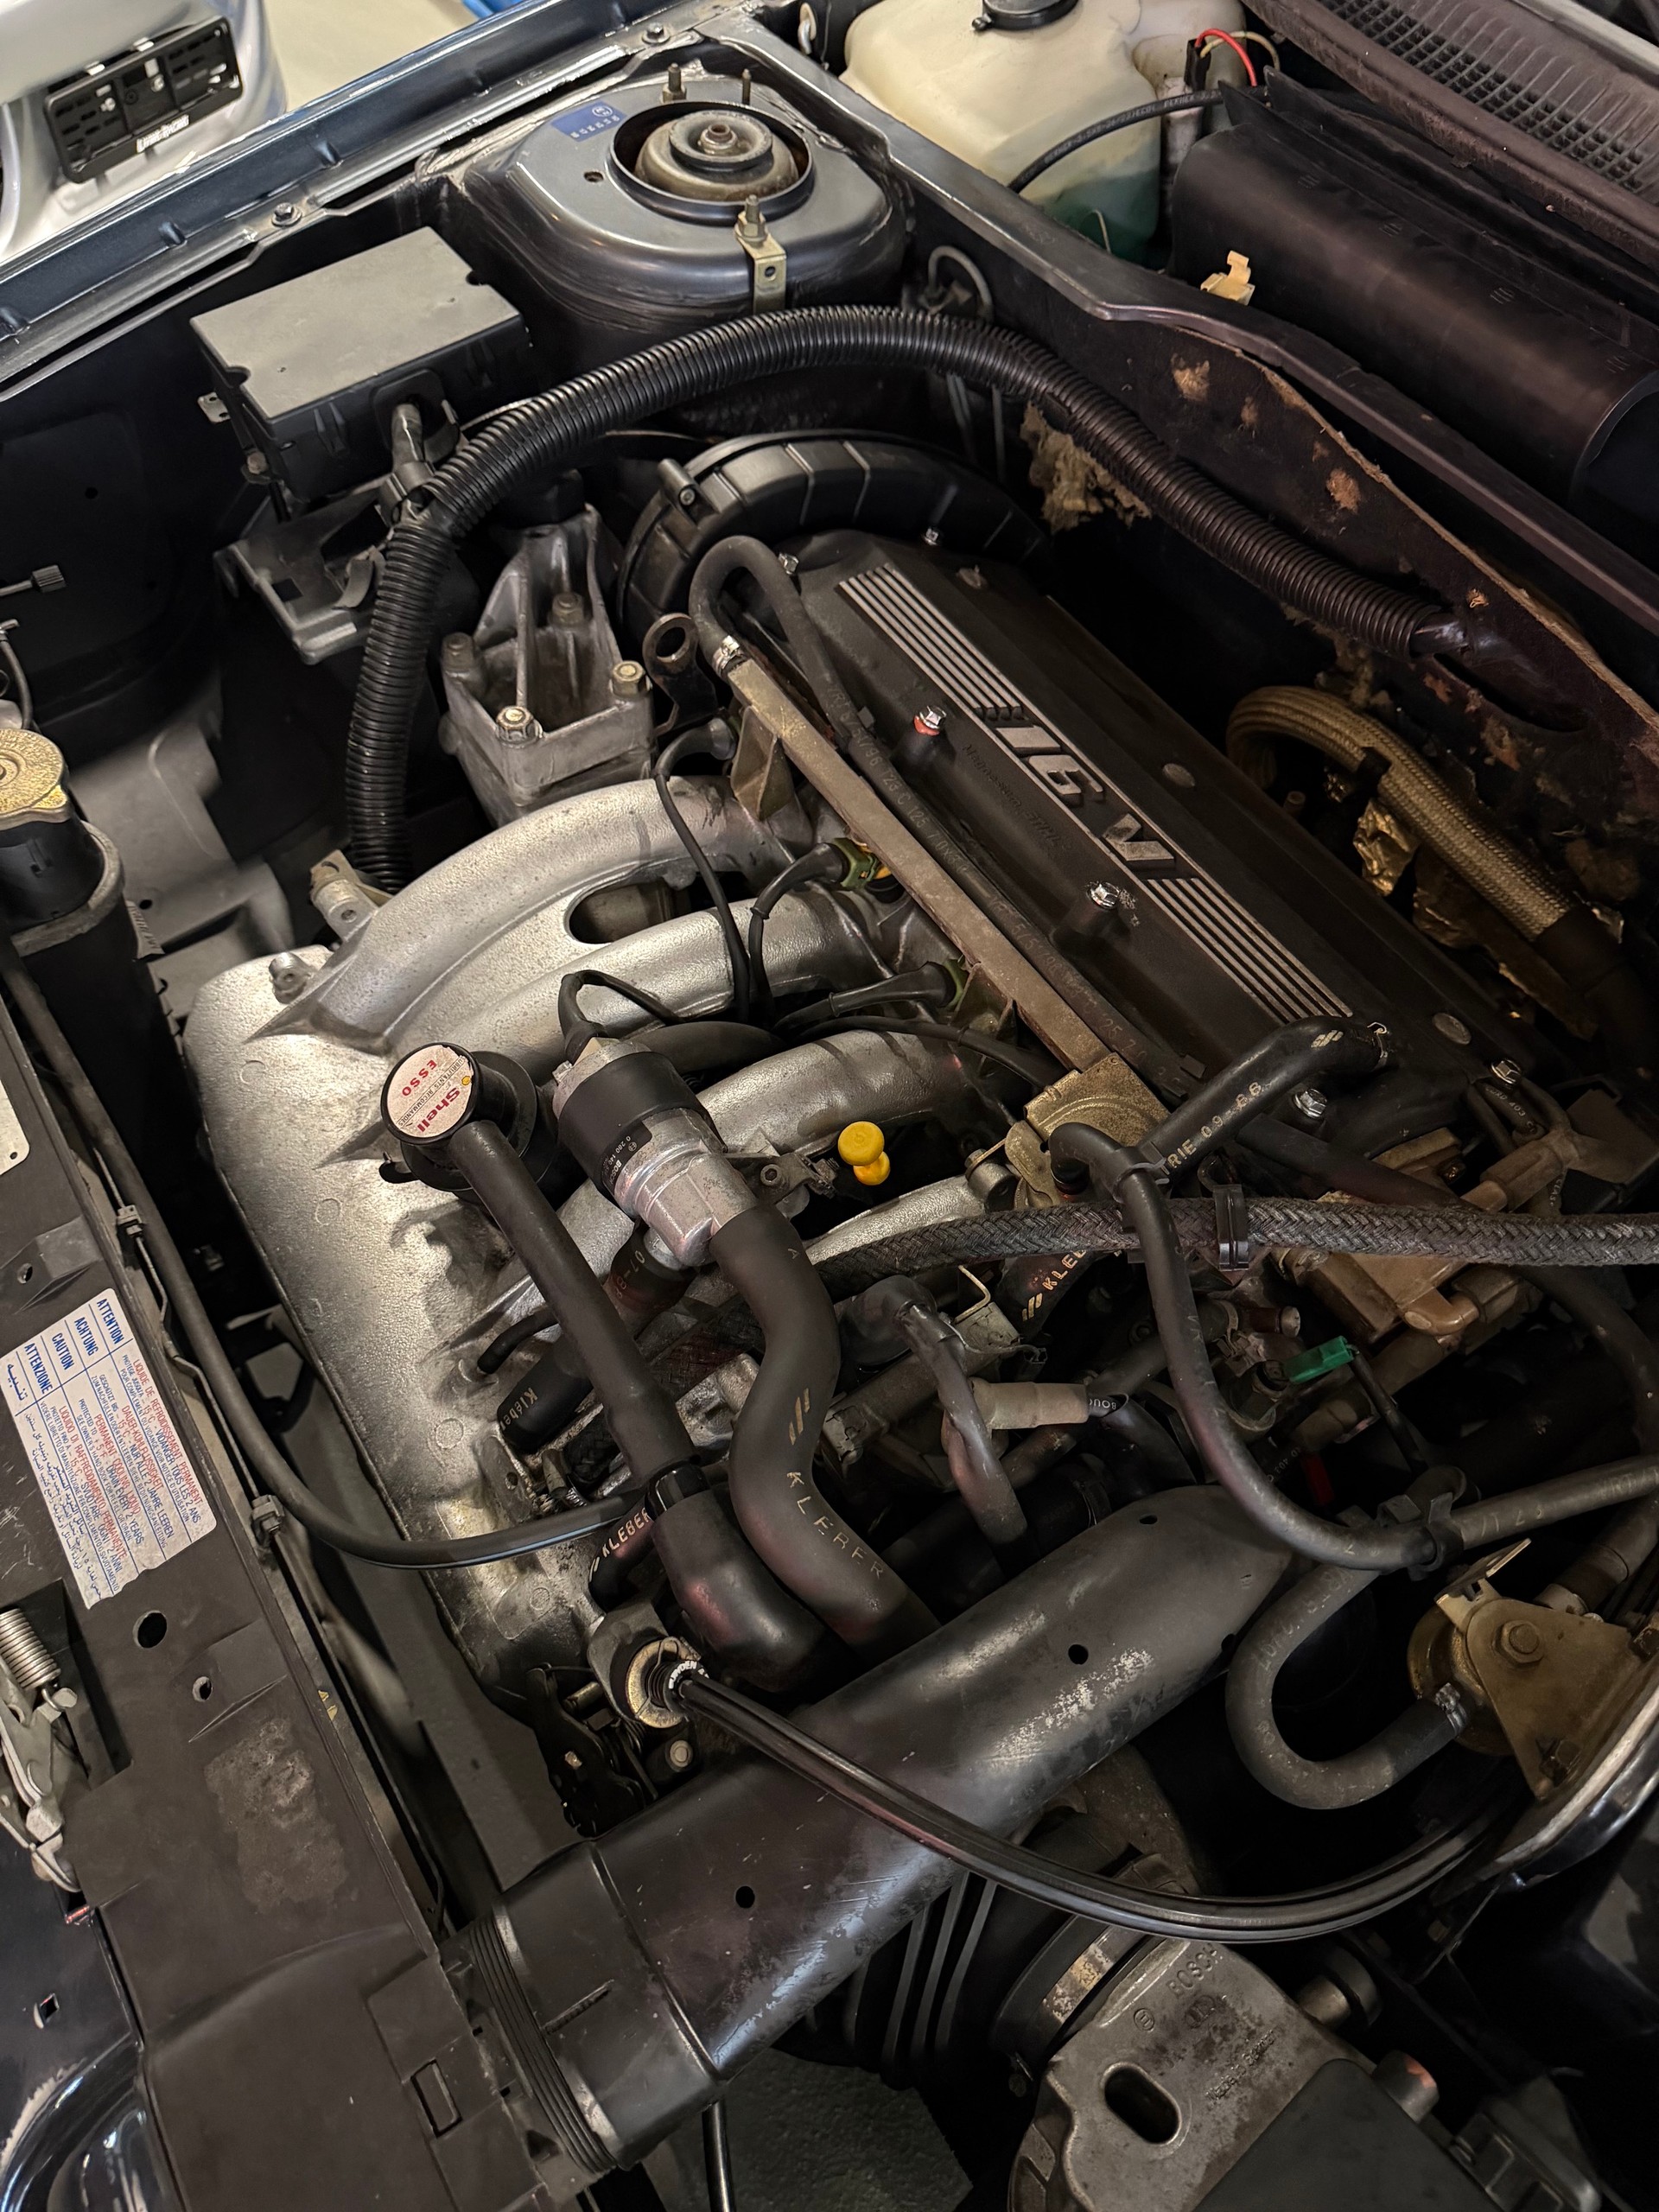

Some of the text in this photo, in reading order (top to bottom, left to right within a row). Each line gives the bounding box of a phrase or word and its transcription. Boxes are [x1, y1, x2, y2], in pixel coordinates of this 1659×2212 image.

[400, 1058, 437, 1098] ESSO
[416, 1084, 461, 1134] Shell
[607, 1159, 621, 1184] BOSCH
[73, 1316, 99, 1356] ACHTUNG
[96, 1297, 125, 1344] ATTENTION
[23, 1342, 54, 1394] ATTENZIONE
[50, 1332, 75, 1370] CAUTION
[1, 1362, 29, 1402] تنبيه
[119, 1368, 130, 1382] POUR
[39, 1401, 51, 1421] VEDERE
[125, 1382, 144, 1417] COMPLEMENT
[47, 1421, 62, 1447] LIBRETTO
[75, 1414, 85, 1426] SEE
[91, 1375, 100, 1388] ZUM
[110, 1421, 120, 1435] ODER
[116, 1435, 133, 1466] ENTLEEREN
[130, 1466, 141, 1483] SIEHE
[131, 1358, 203, 1504] LIQUIDE DE REFROIDISSEMENT PERMANENT
[140, 1416, 149, 1426] OU
[143, 1424, 159, 1449] VIDANGE
[60, 1452, 81, 1495] MANUTENZIONE
[78, 1398, 94, 1427] PROTECTED
[105, 1464, 121, 1488] DRAIN
[114, 1487, 130, 1511] EVERY
[127, 1518, 144, 1544] YEARS
[91, 1450, 102, 1466] HAND
[93, 1414, 141, 1515] PERMANENT COOLING LIQUID
[97, 1466, 108, 1482] BOOK
[154, 1427, 176, 1465] VIDANGER
[169, 1464, 185, 1485] TOUS
[178, 1484, 191, 1500] LES
[188, 1506, 201, 1523] ANS
[155, 1449, 164, 1463] VOIR
[160, 1462, 174, 1483] NOTICE
[49, 1406, 64, 1431] PROTETTO
[79, 1481, 102, 1521] SVUOTARE
[97, 1523, 111, 1544] OGNI
[109, 1554, 123, 1573] ANNI
[58, 1405, 127, 1559] LIQUIDO DI RAFFREDDAMENTO PERMANENTE
[77, 1495, 86, 1506] PER
[104, 1482, 113, 1494] FOR
[128, 1443, 142, 1460] NUR
[135, 1459, 149, 1479] ALLE
[146, 1485, 163, 1510] JAHRE
[156, 1509, 175, 1538] LEEREN
[109, 1494, 121, 1514] REFILL
[117, 1514, 124, 1522] OR
[80, 1505, 102, 1547] COMPLEMENTO
[120, 1522, 132, 1541] DRAIN
[99, 1551, 120, 1591] SVUOTAMENTO
[1164, 1940, 1223, 1999] BOSCH
